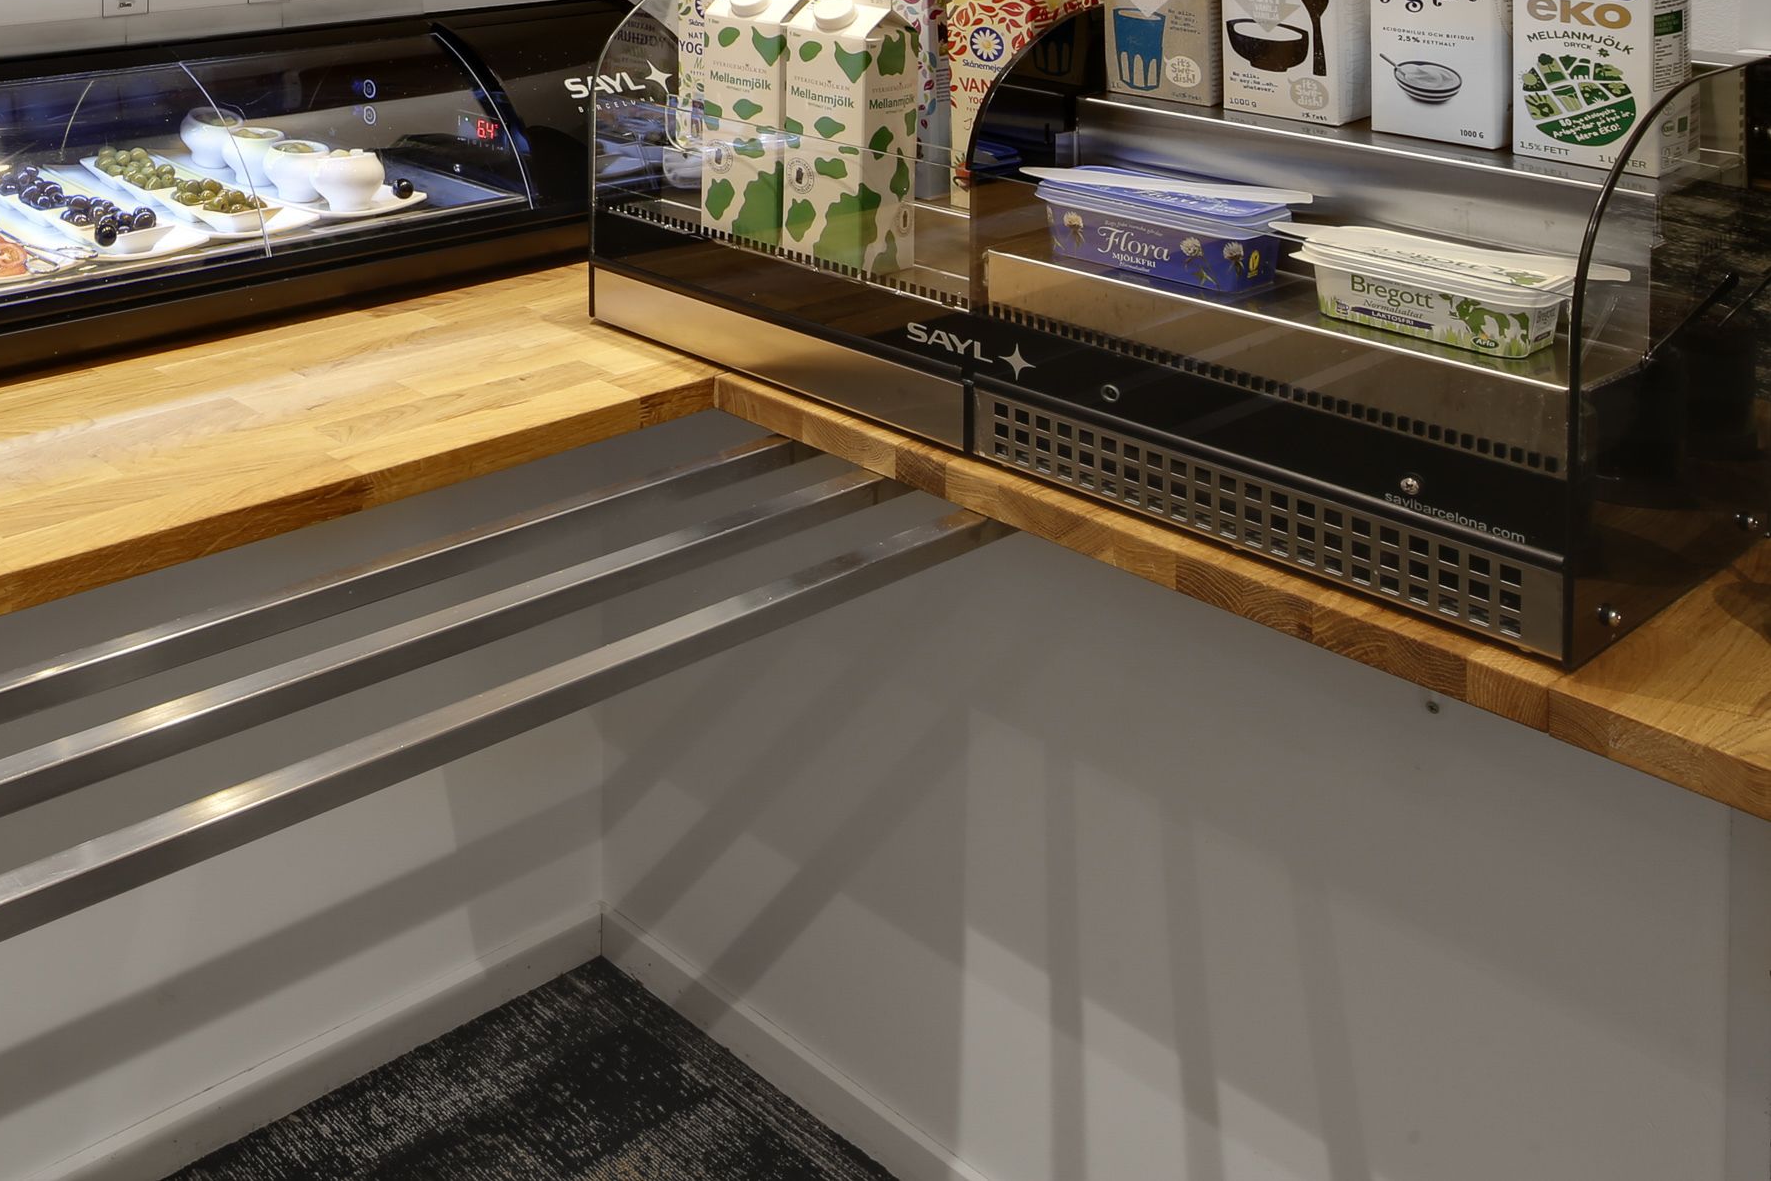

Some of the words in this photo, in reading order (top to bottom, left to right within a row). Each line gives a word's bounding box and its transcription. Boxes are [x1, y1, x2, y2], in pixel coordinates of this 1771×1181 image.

[1382, 26, 1426, 36] ACIDOPHILUS
[1423, 39, 1456, 48] FETTHALT
[1526, 29, 1634, 55] MELLANMJÖLK
[1563, 41, 1592, 51] DRYCK
[563, 71, 646, 99] SAYL
[710, 70, 772, 91] Mellanmjölk
[578, 96, 655, 113] BRCELONA
[791, 85, 855, 109] Mellanmjölk
[869, 94, 916, 112] Mellanmjölk
[1229, 97, 1250, 106] 1000
[1460, 129, 1477, 138] 1000
[1478, 131, 1484, 139] G
[1575, 131, 1599, 142] Mera
[1598, 122, 1621, 135] EKO!
[1519, 141, 1542, 152] 1,5%
[1543, 145, 1570, 156] FETT
[1598, 154, 1605, 162] 1
[1608, 155, 1647, 169] LIER
[1097, 226, 1170, 261] Flora
[1112, 252, 1156, 268] MJÖLKFRI
[1350, 274, 1434, 309] Bregott
[1363, 298, 1424, 320] Normalsaltat
[1371, 310, 1414, 326] LAKTOSFRI
[907, 322, 993, 363] SAYL
[1475, 337, 1497, 348] Arla
[1384, 492, 1525, 544] saylbarcelona.com
